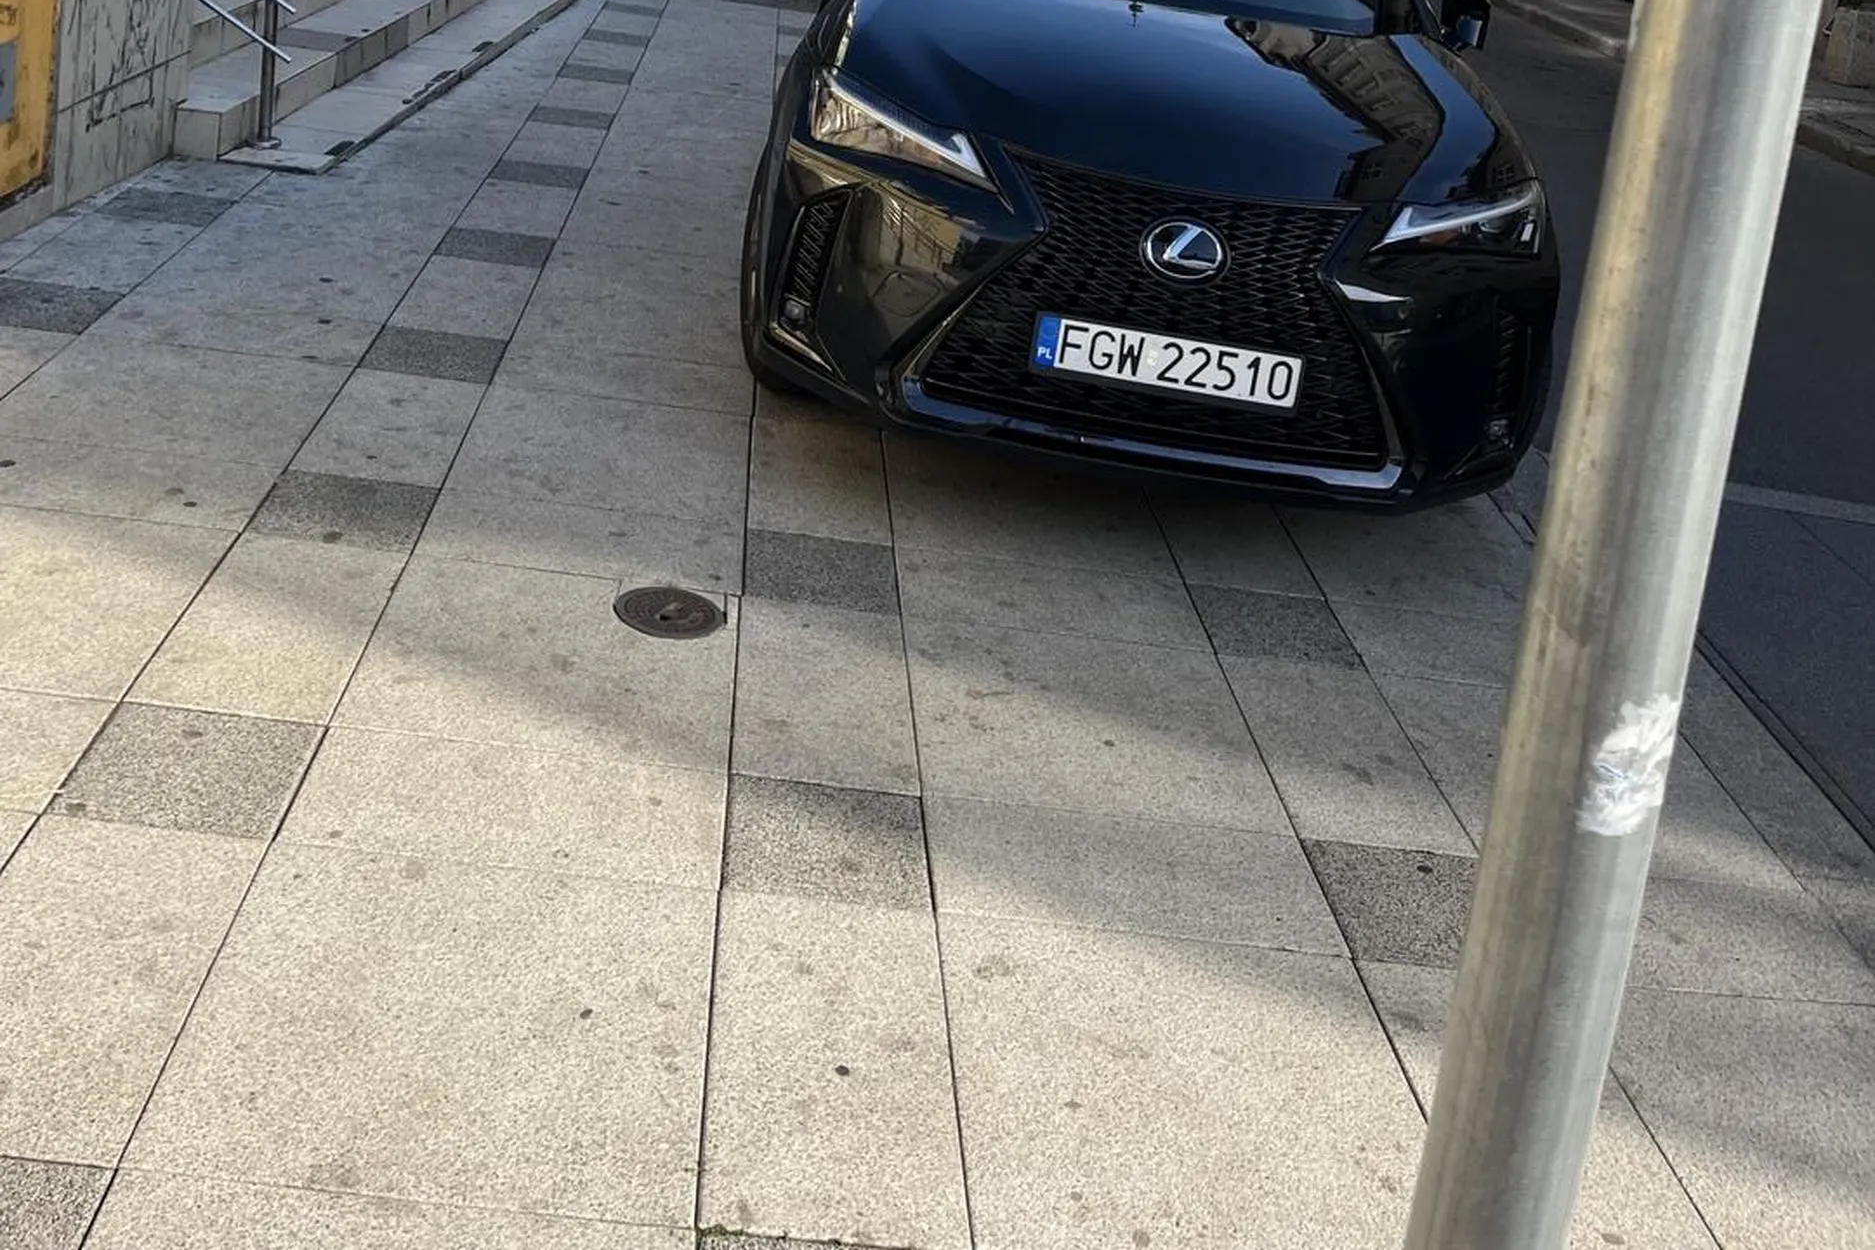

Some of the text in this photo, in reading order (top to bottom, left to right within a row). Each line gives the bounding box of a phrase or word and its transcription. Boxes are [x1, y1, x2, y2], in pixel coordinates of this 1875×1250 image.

[1037, 346, 1053, 359] PL
[1059, 324, 1294, 400] FGW 22510
